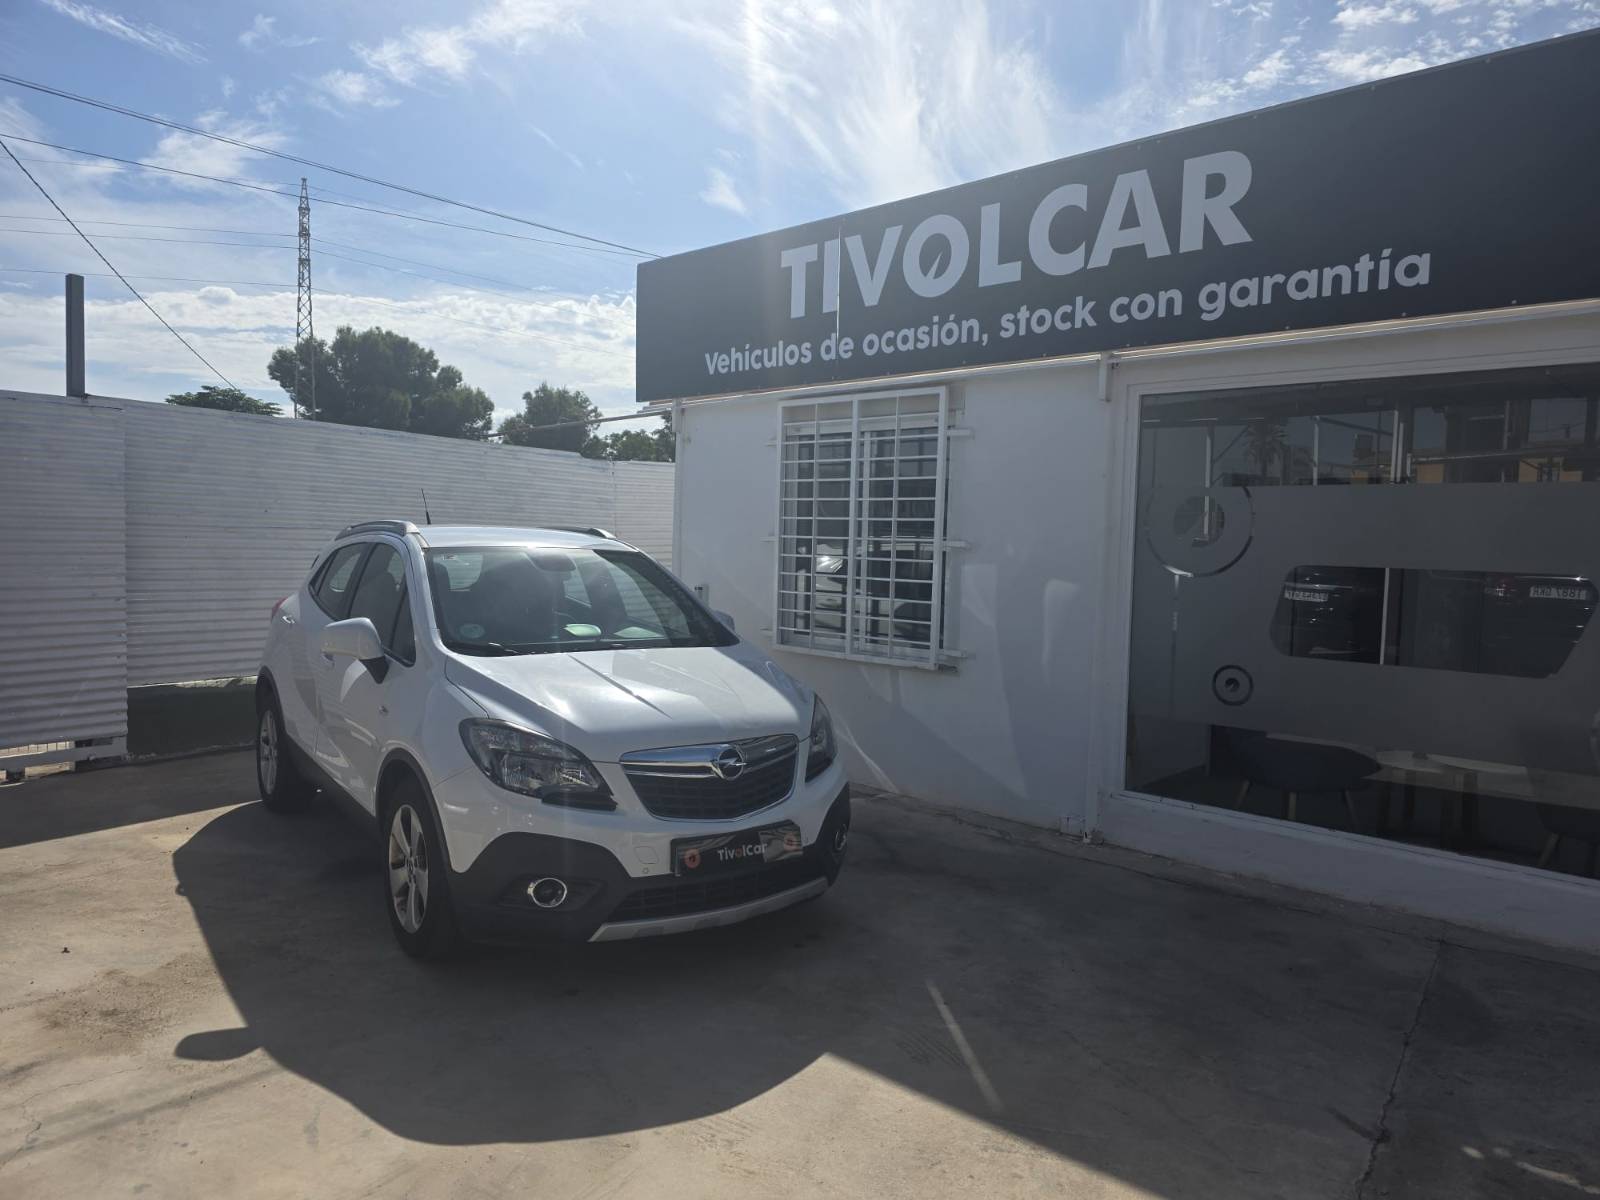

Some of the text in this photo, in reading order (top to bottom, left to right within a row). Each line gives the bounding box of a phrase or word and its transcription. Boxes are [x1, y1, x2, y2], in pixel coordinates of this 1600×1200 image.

[780, 150, 1253, 318] TIVOLCAR
[705, 248, 1432, 376] Vehículos de ocasión, stock con garantía
[717, 843, 768, 862] TivolCar
